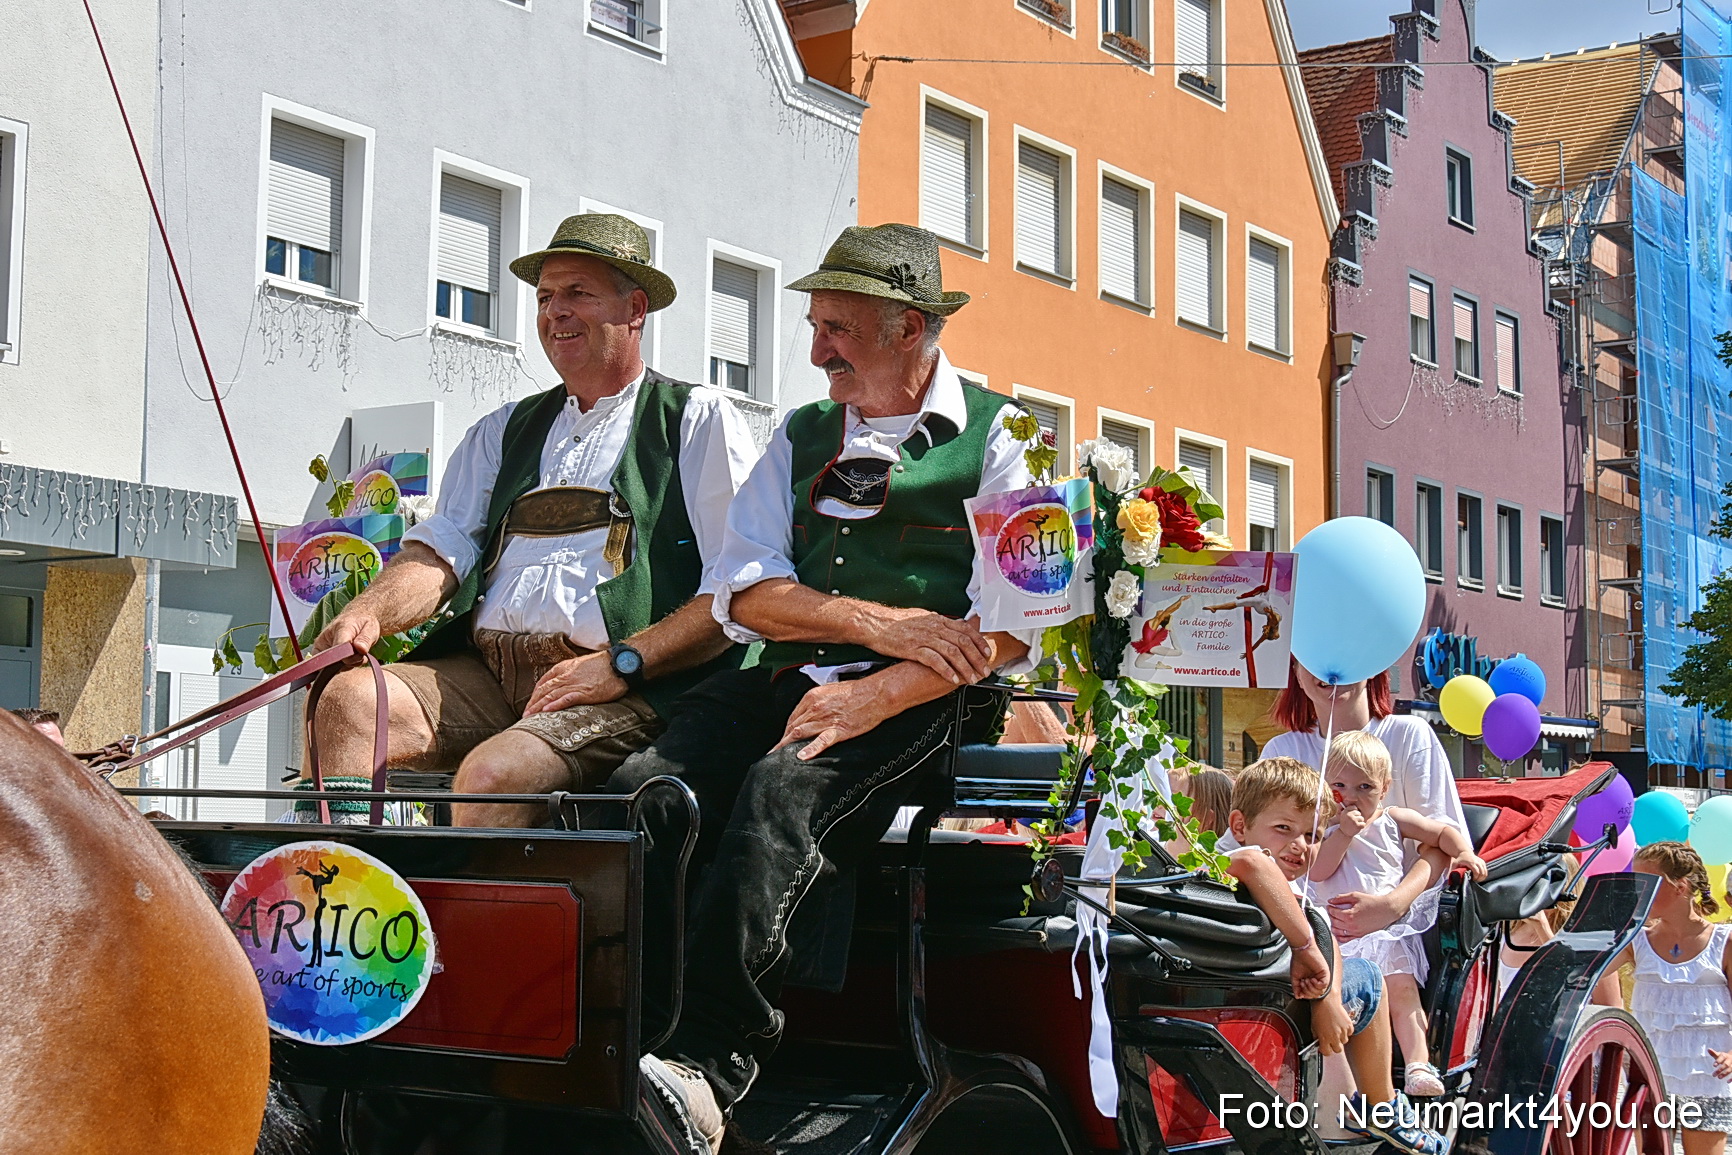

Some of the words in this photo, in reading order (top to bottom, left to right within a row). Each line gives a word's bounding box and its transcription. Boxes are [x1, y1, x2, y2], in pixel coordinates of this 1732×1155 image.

[1008, 567, 1031, 581] art
[1031, 563, 1048, 580] of
[1210, 573, 1250, 584] entfalten
[1161, 584, 1182, 593] und
[1185, 584, 1237, 595] Eintauchen
[1179, 618, 1191, 626] in
[1192, 618, 1207, 627] die
[1208, 618, 1234, 630] große
[1191, 630, 1229, 639] ARTICO-
[1196, 642, 1231, 651] Familie
[1173, 666, 1242, 677] www.artico.de
[271, 968, 311, 987] art
[313, 968, 340, 997] of
[340, 975, 414, 1003] sports
